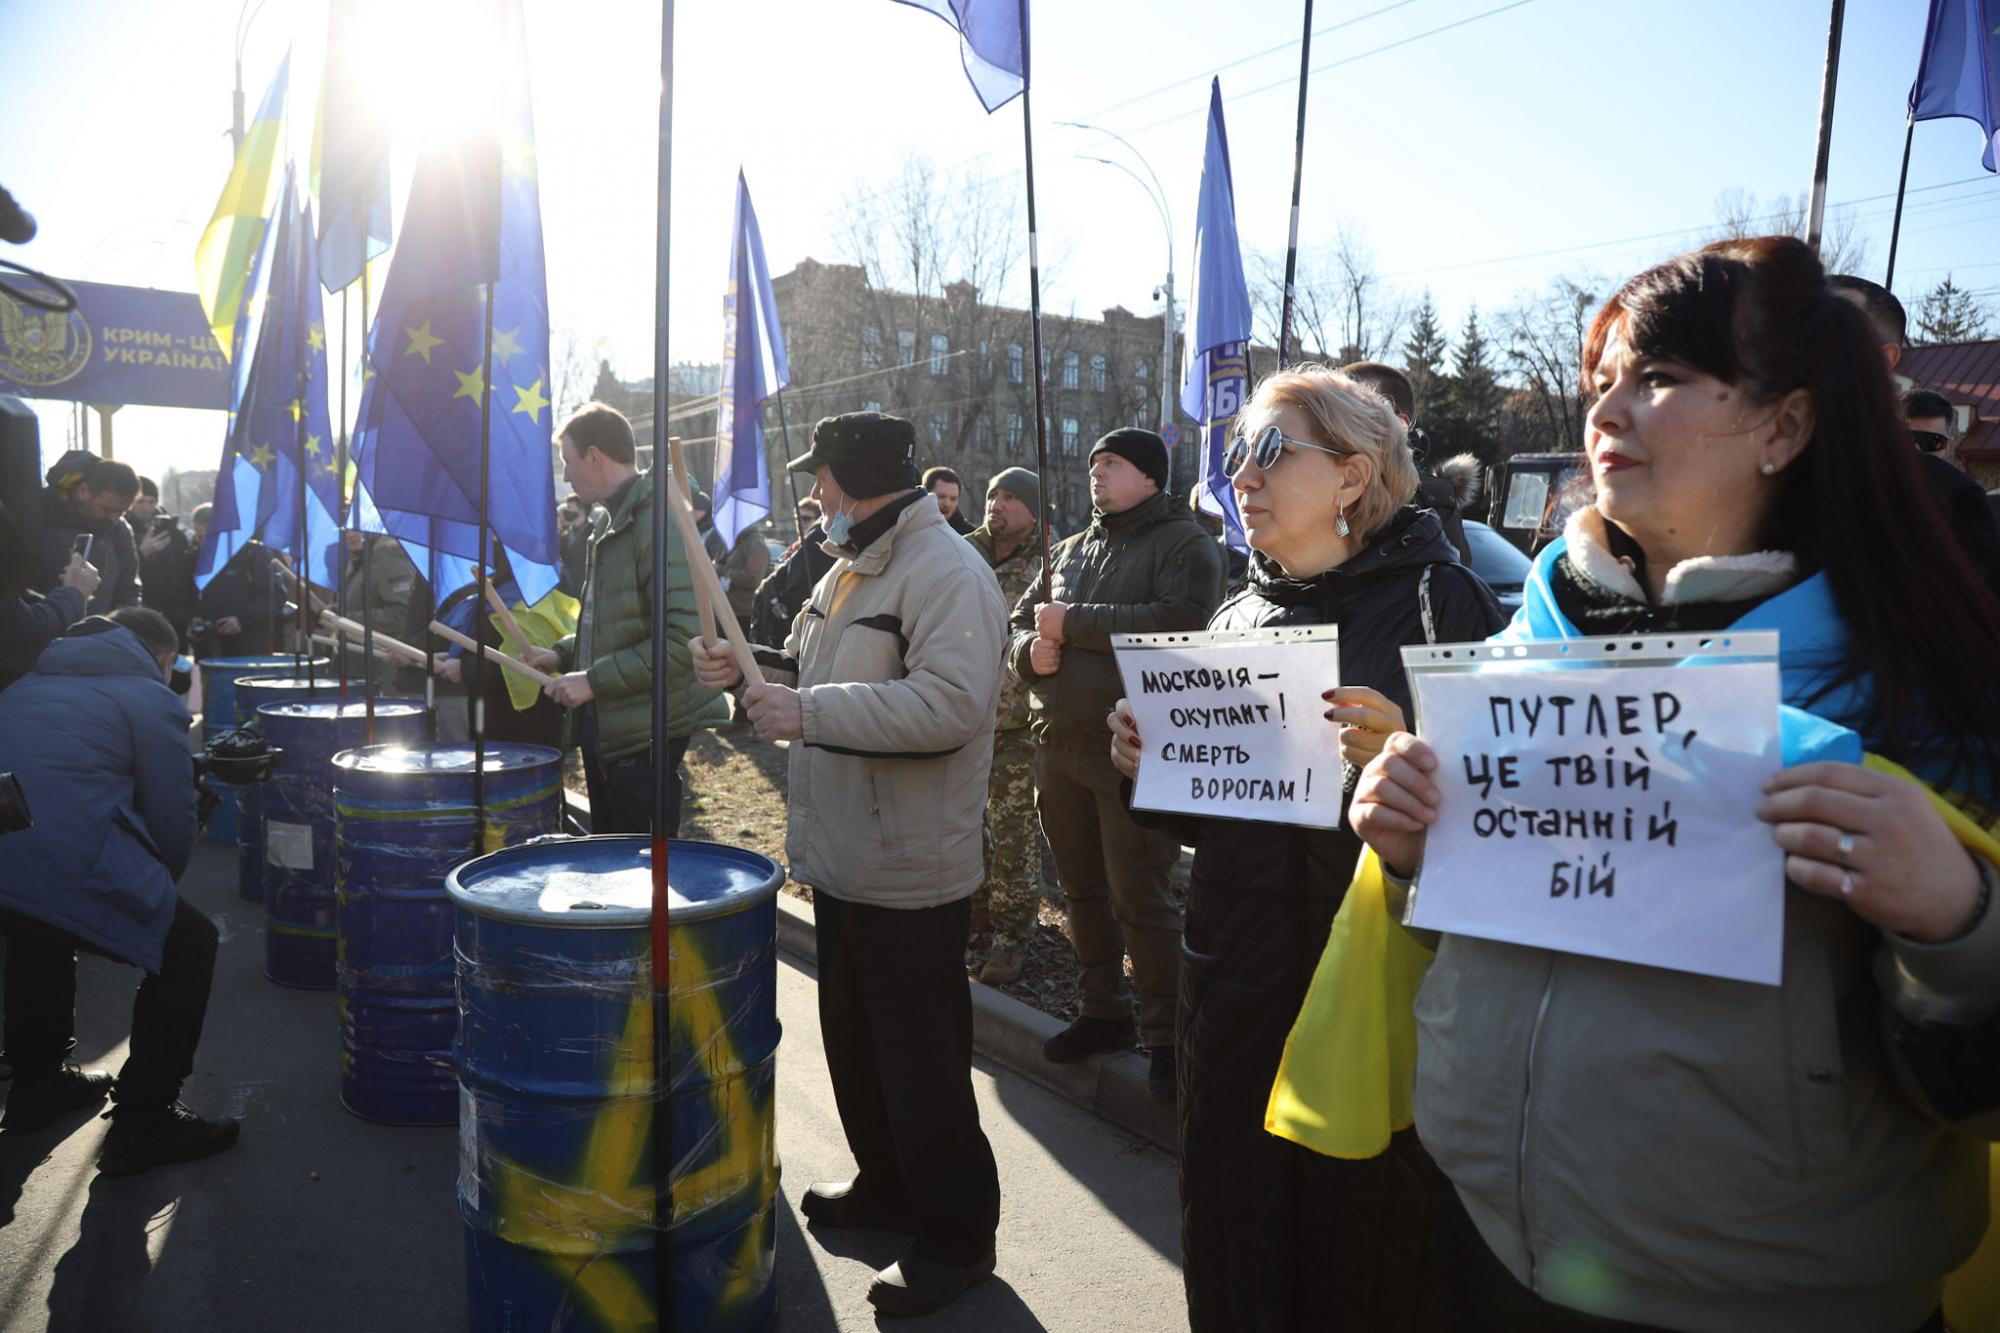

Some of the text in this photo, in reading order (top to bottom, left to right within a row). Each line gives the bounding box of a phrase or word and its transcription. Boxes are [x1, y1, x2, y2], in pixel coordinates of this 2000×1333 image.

[103, 327, 171, 347] КРИМ
[1169, 692, 1287, 729] ОКУПАНТ!
[1489, 691, 1697, 749] ПУТЛЕР,
[1161, 742, 1250, 767] СМЕРТЬ
[1191, 768, 1312, 802] ВОРОГАМ!
[1463, 753, 1521, 800] ЦЕ
